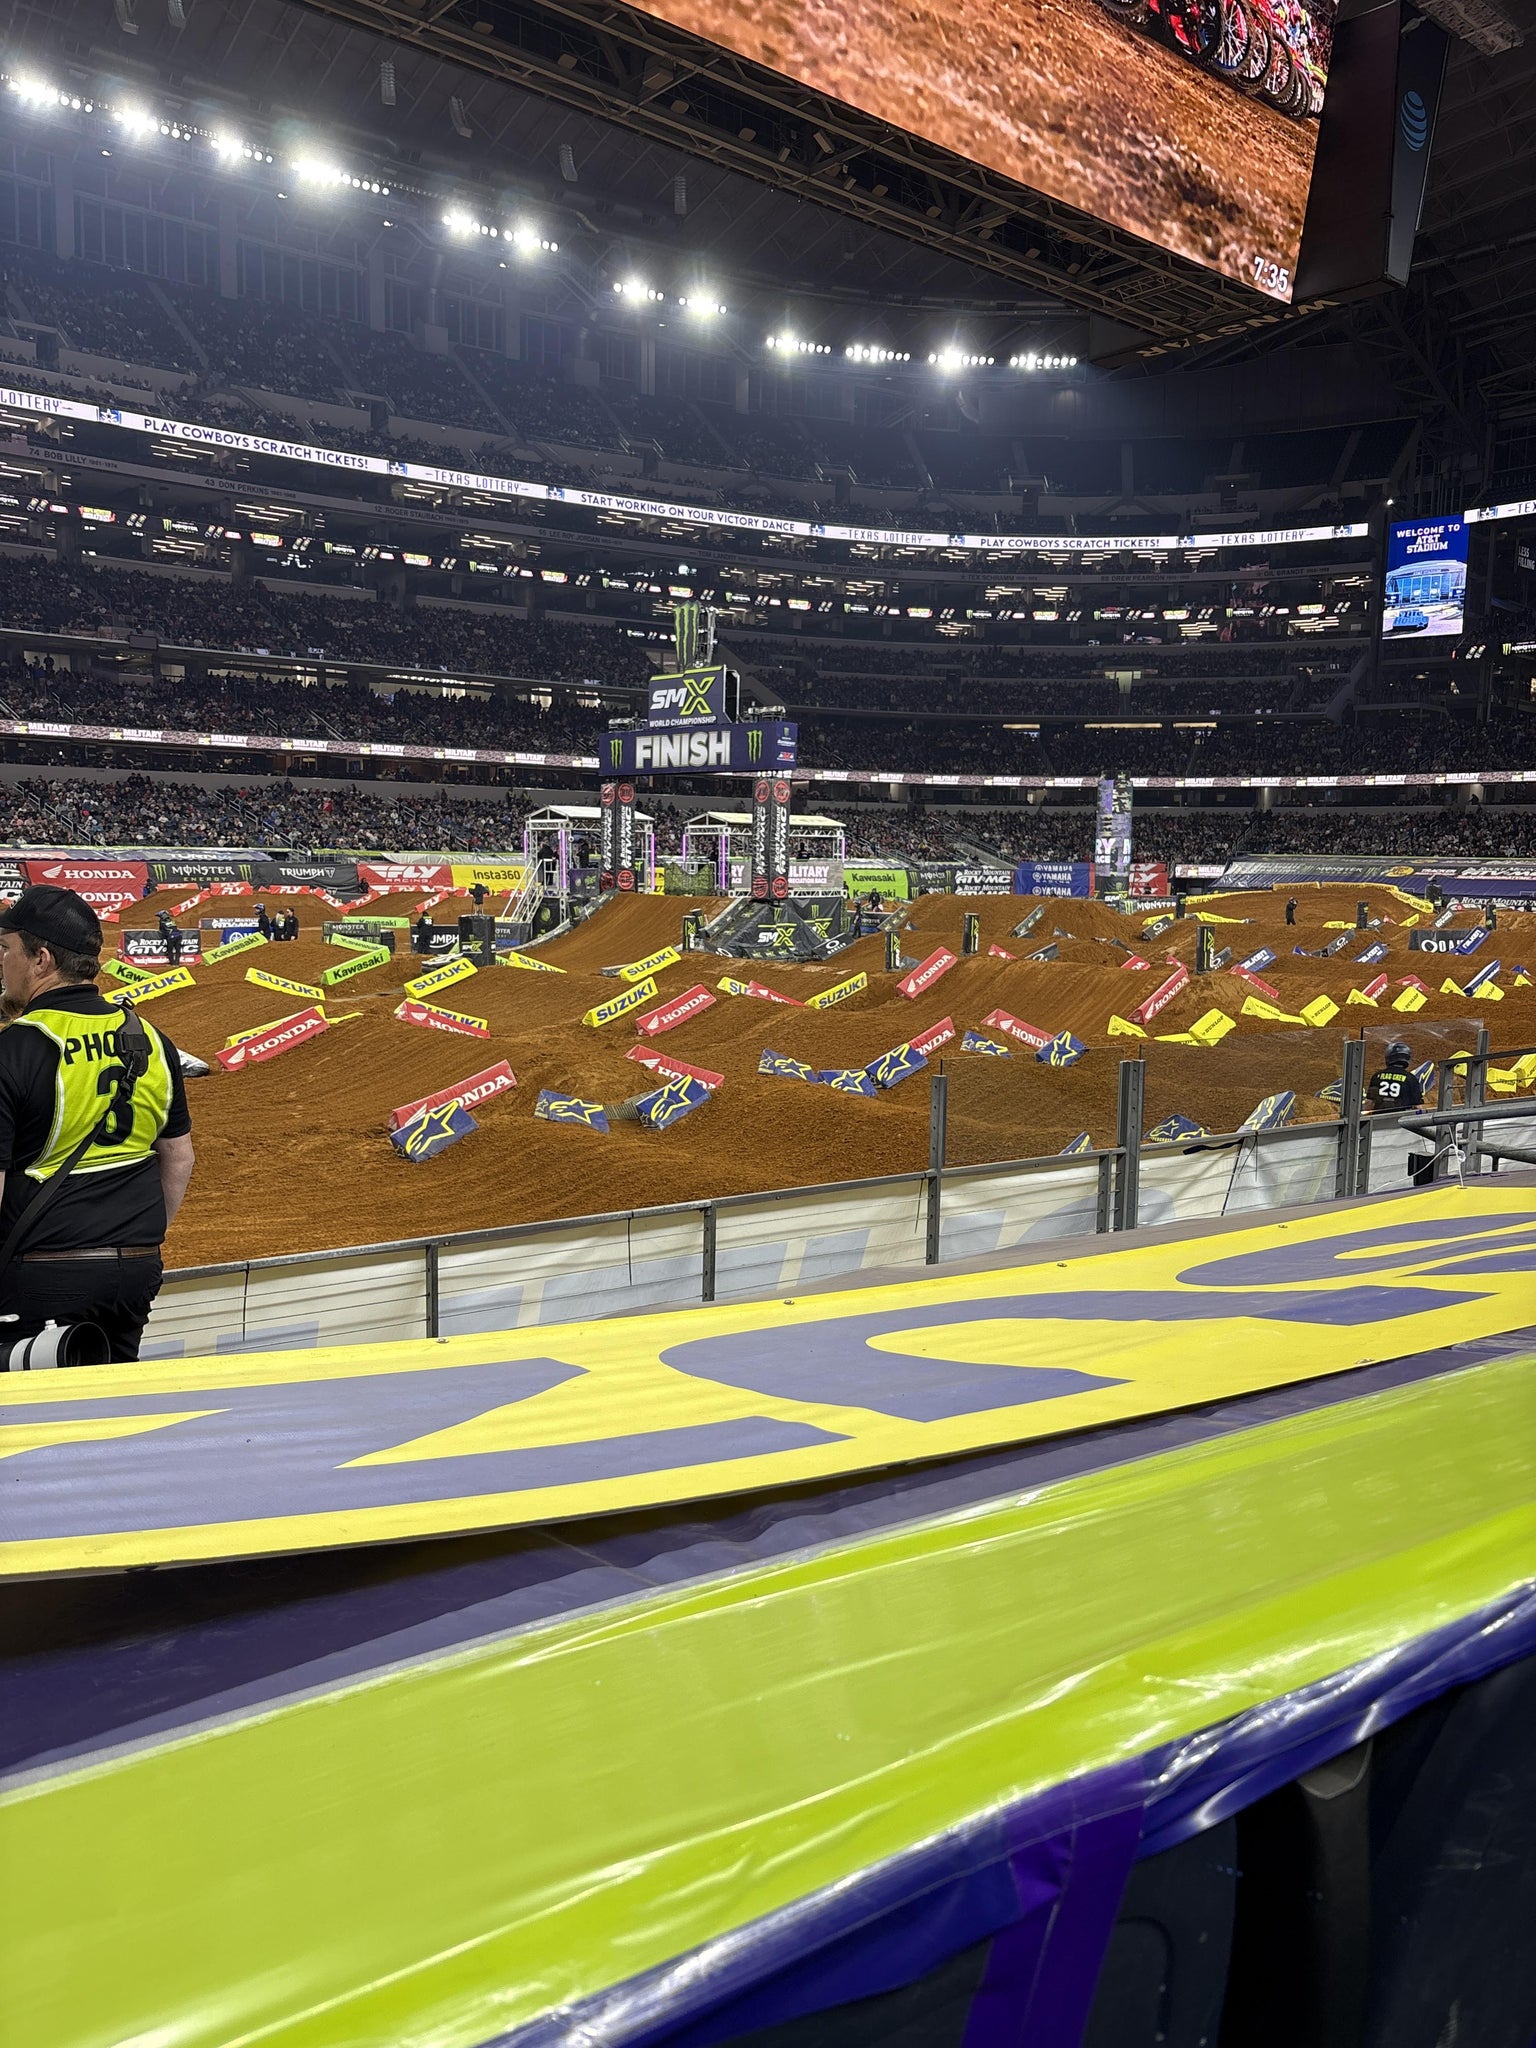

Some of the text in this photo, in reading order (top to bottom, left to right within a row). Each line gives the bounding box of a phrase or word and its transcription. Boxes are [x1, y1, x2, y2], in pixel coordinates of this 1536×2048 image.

[1254, 256, 1289, 292] 7:35
[0, 390, 61, 411] LOTTERY
[144, 419, 370, 469] PLAY COWBOYS SCRATCH TICKETS!
[29, 447, 87, 464] 74 BOB LILLY
[204, 478, 270, 495] 43 DON PERKINS
[434, 470, 521, 493] TEXAS LOTTERY
[581, 493, 796, 533] START WORKING ON YOUR VICTORY DANCE
[848, 528, 924, 545] TEXAS LOTTERY
[1220, 529, 1305, 546] TEXAS LOTTERY
[1396, 524, 1461, 539] WELCOME TO
[1416, 533, 1441, 546] AT&T
[980, 538, 1160, 549] PLAY COWBOYS SCRATCH TICKETS!
[1406, 541, 1449, 554] STADIUM
[650, 677, 716, 715] SMX
[28, 723, 71, 734] MILITARY
[649, 716, 717, 728] WORLD CHAMPIONSHIP
[123, 729, 162, 740] MILITARY
[211, 735, 248, 744] MILITARY
[635, 731, 732, 769] FINISH
[63, 869, 137, 879] HONDA
[171, 865, 235, 876] MONSTER
[279, 867, 326, 879] TRIUMPH
[374, 866, 442, 879] FLY
[472, 868, 521, 881] Insta360
[851, 873, 896, 883] Kawasaki
[1041, 872, 1072, 882] YAMAHA
[221, 887, 245, 895] FLY
[280, 886, 300, 894] FLY
[181, 892, 201, 912] FLY
[321, 892, 343, 908] FLY
[355, 894, 372, 907] FLY
[423, 898, 441, 911] FLY
[1461, 896, 1490, 905] ROCKY
[140, 938, 162, 946] ROCKY
[757, 927, 796, 947] SMX
[211, 935, 260, 960] Kawasaki
[332, 956, 384, 980] Kawasaki
[626, 951, 675, 977] SUZUKI
[916, 954, 953, 986] HONDA
[255, 972, 320, 998] SUZUKI
[412, 962, 470, 991] SUZUKI
[112, 972, 187, 1005] SUZUKI
[818, 977, 866, 1009] SUZUKI
[1153, 976, 1190, 1012] HONDA
[595, 982, 654, 1022] SUZUKI
[661, 993, 710, 1024] HONDA
[248, 1018, 322, 1057] HONDA
[63, 1031, 119, 1066] PHO
[1378, 1081, 1401, 1098] 29
